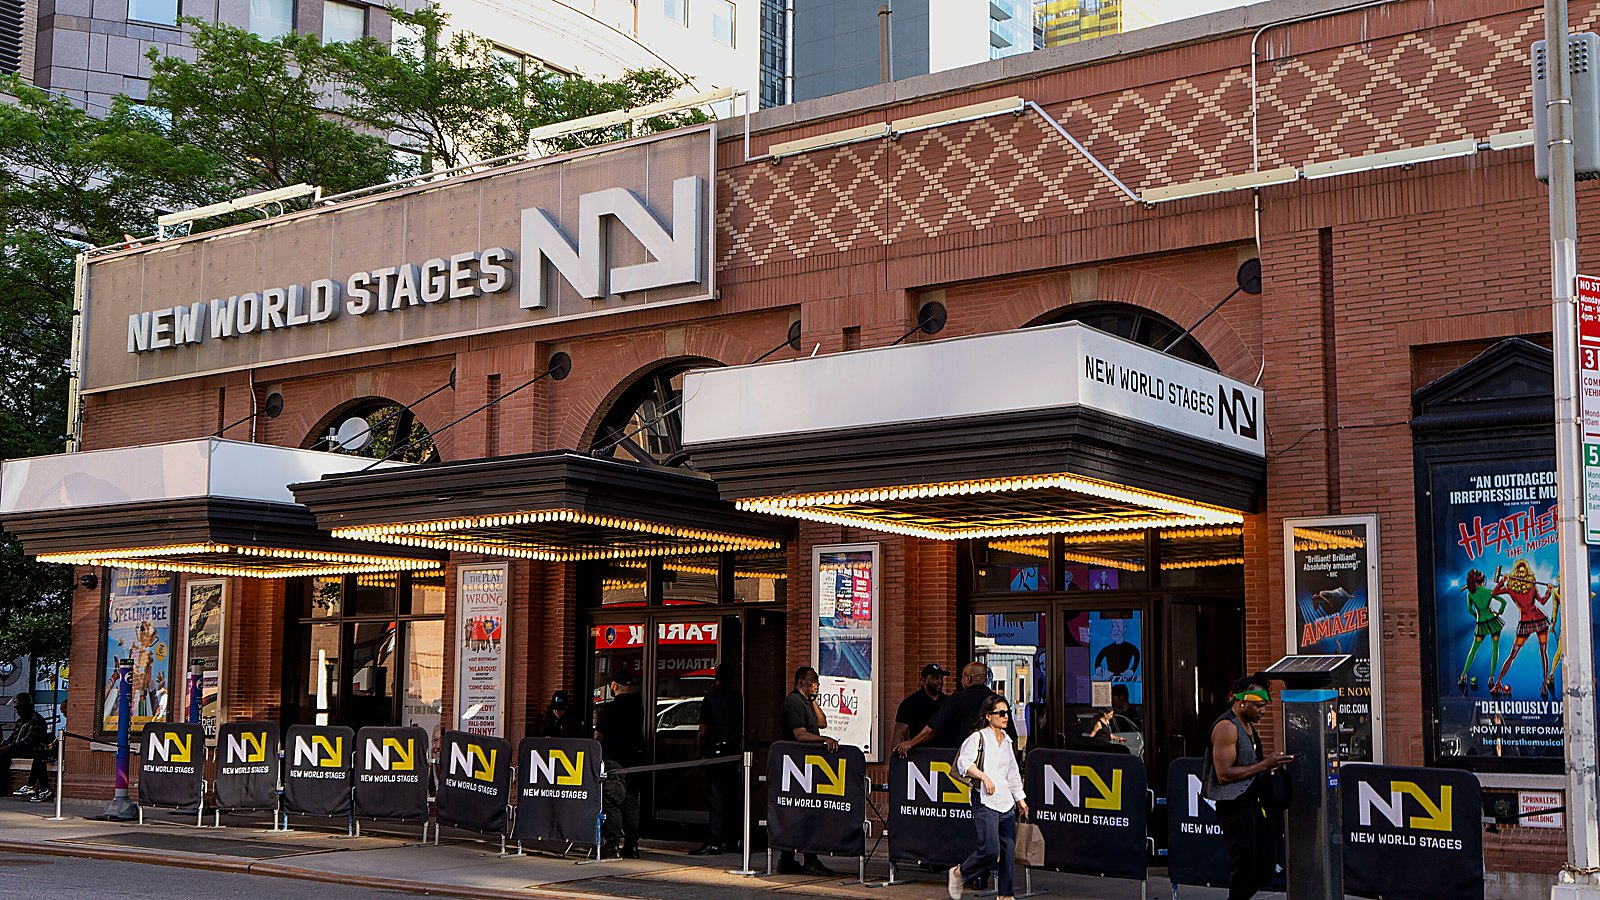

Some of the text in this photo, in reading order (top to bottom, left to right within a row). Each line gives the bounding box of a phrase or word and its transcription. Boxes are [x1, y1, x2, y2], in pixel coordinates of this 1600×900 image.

[1580, 280, 1600, 292] NO ST
[127, 246, 513, 354] NEW WORLD STAGES
[1584, 349, 1594, 369] 3
[1085, 355, 1214, 417] NEW WORLD STAGES
[1589, 446, 1598, 465] 5
[1450, 486, 1557, 504] IRREPRESSIBLE MU
[1504, 545, 1524, 558] THE
[1303, 562, 1331, 571] Absolutely
[482, 573, 500, 582] PLAY
[466, 593, 503, 606] WRONG
[114, 606, 167, 623] SPELLING BEE
[1301, 607, 1368, 647] AMAZE
[1338, 703, 1368, 714] GIC.COM
[1473, 725, 1498, 734] NOW
[1501, 726, 1511, 734] IN
[143, 764, 194, 774] NEW WORLD STAGES
[234, 766, 250, 774] WORLD
[250, 765, 269, 774] STAGES
[290, 770, 346, 780] NEW WORLD STAGES
[361, 774, 418, 783] NEW WORLD STAGES
[445, 778, 498, 796] NEW WORLD STAGES
[523, 788, 588, 799] NEW WORLD STAGES
[776, 796, 851, 812] NEW WORLD STAGES
[1522, 796, 1557, 804] SPRINKLERS
[900, 805, 974, 819] NEW WORLD STAG
[1036, 810, 1129, 827] NEW WORLD STAGES
[1180, 822, 1202, 834] NEW
[1350, 831, 1463, 850] NEW WORLD STAGES
